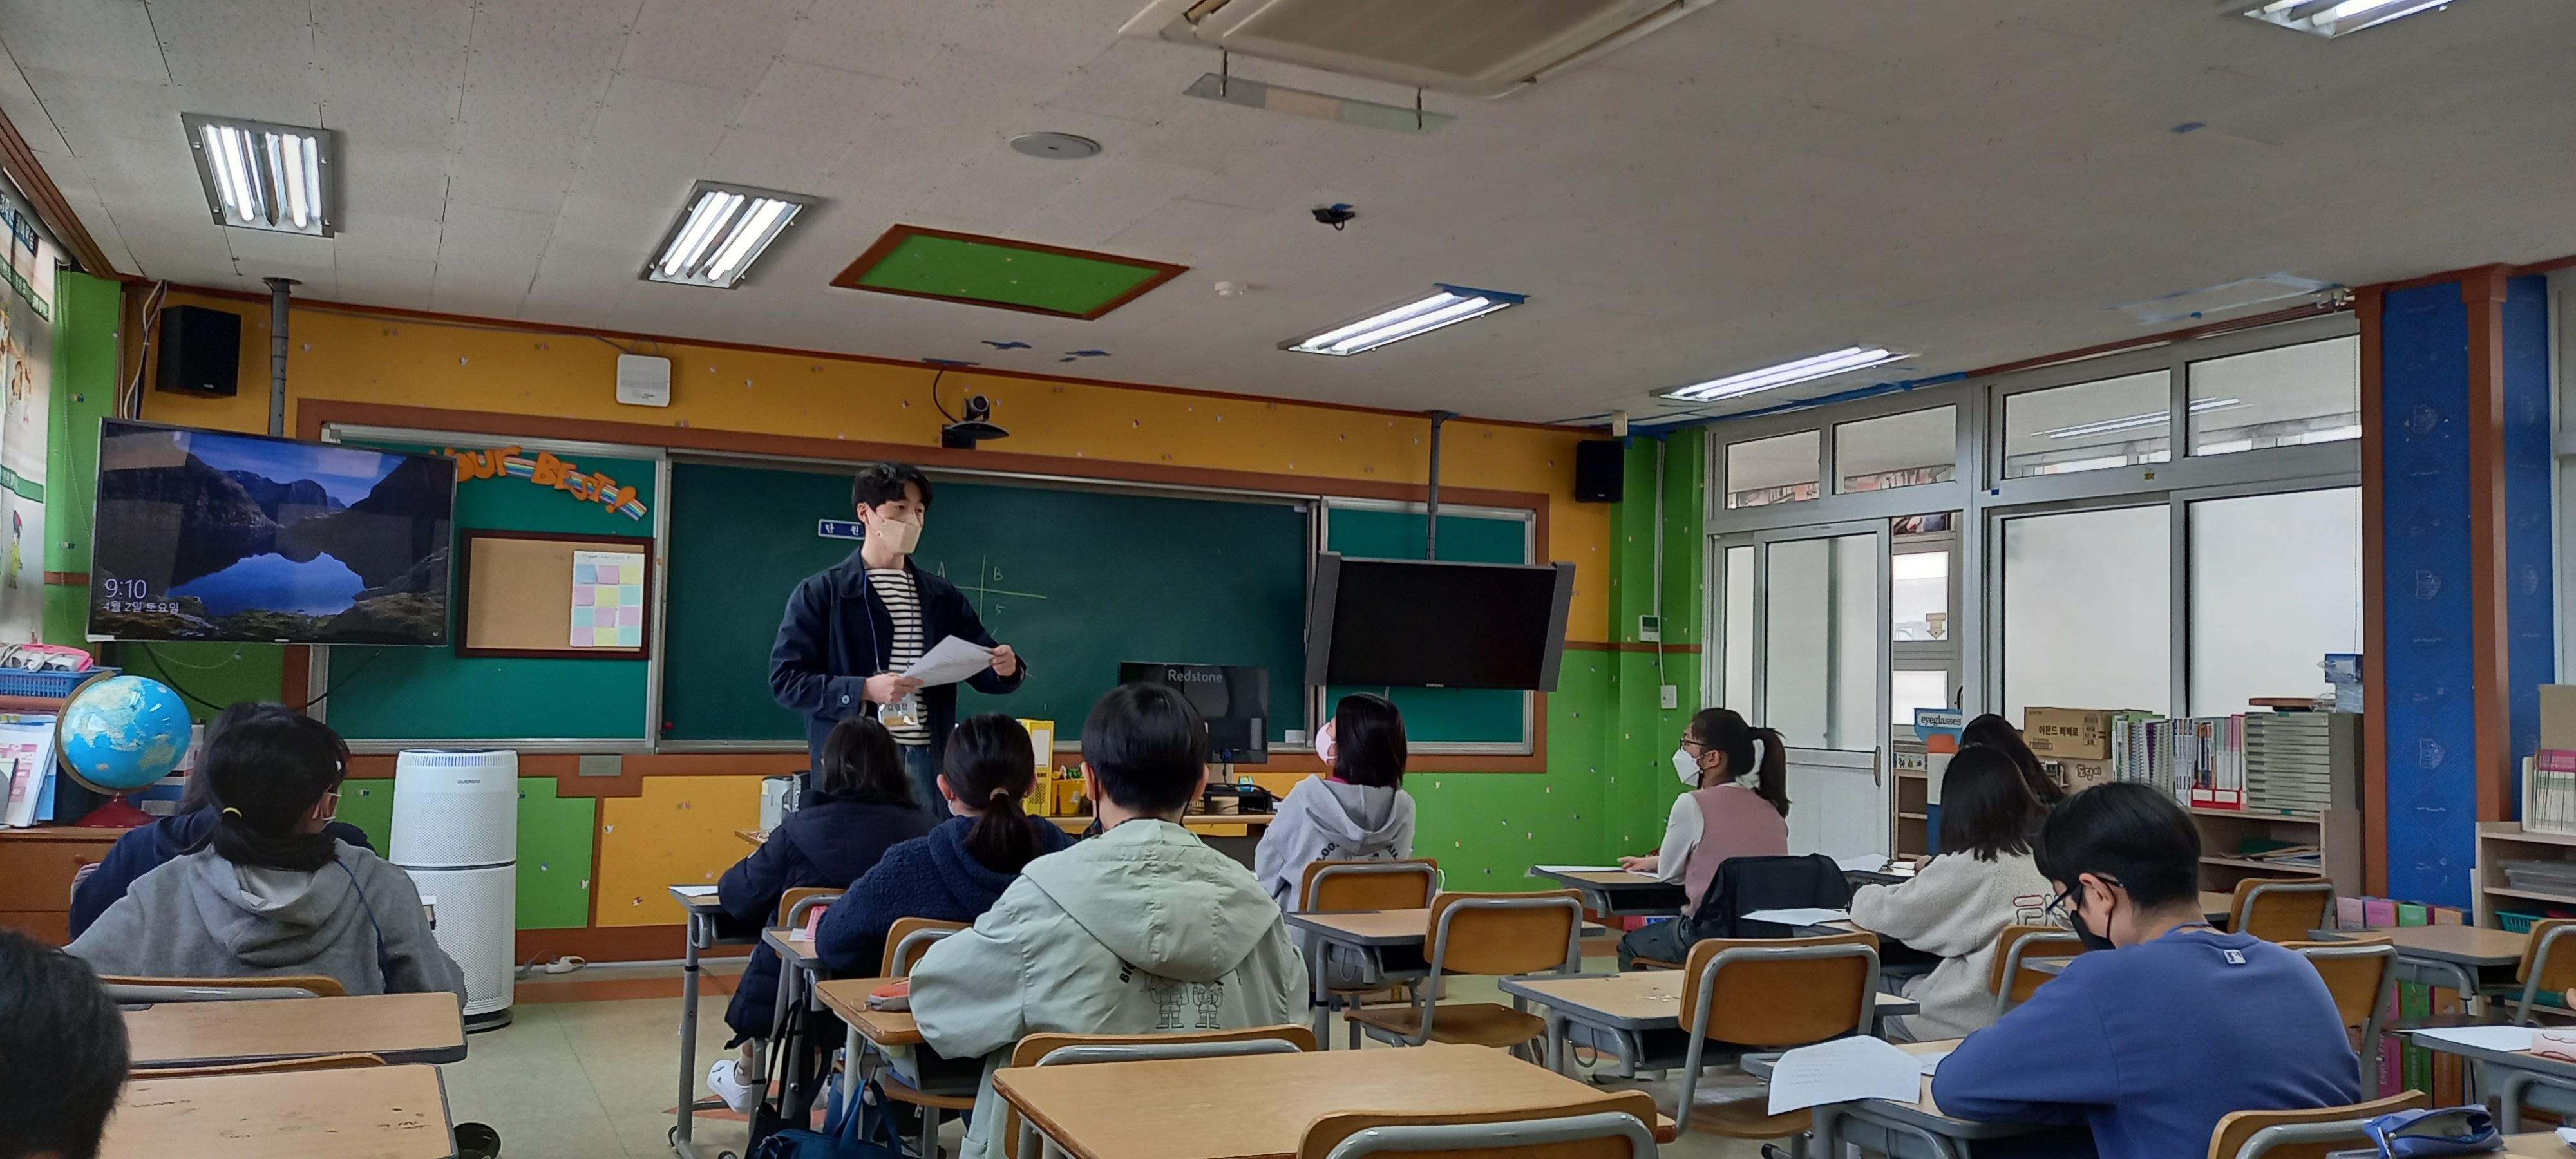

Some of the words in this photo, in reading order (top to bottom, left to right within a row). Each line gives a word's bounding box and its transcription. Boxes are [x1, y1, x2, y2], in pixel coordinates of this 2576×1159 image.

[937, 561, 946, 578] A
[994, 566, 1003, 581] B
[104, 578, 147, 599] 9:10
[103, 600, 121, 612] 4월
[124, 601, 142, 613] 2일
[146, 602, 179, 614] 토요일
[1168, 669, 1223, 683] Redstone
[1921, 715, 1962, 726] eyeglasses
[2039, 725, 2058, 735] 아몬드
[2379, 1055, 2388, 1085] Engli
